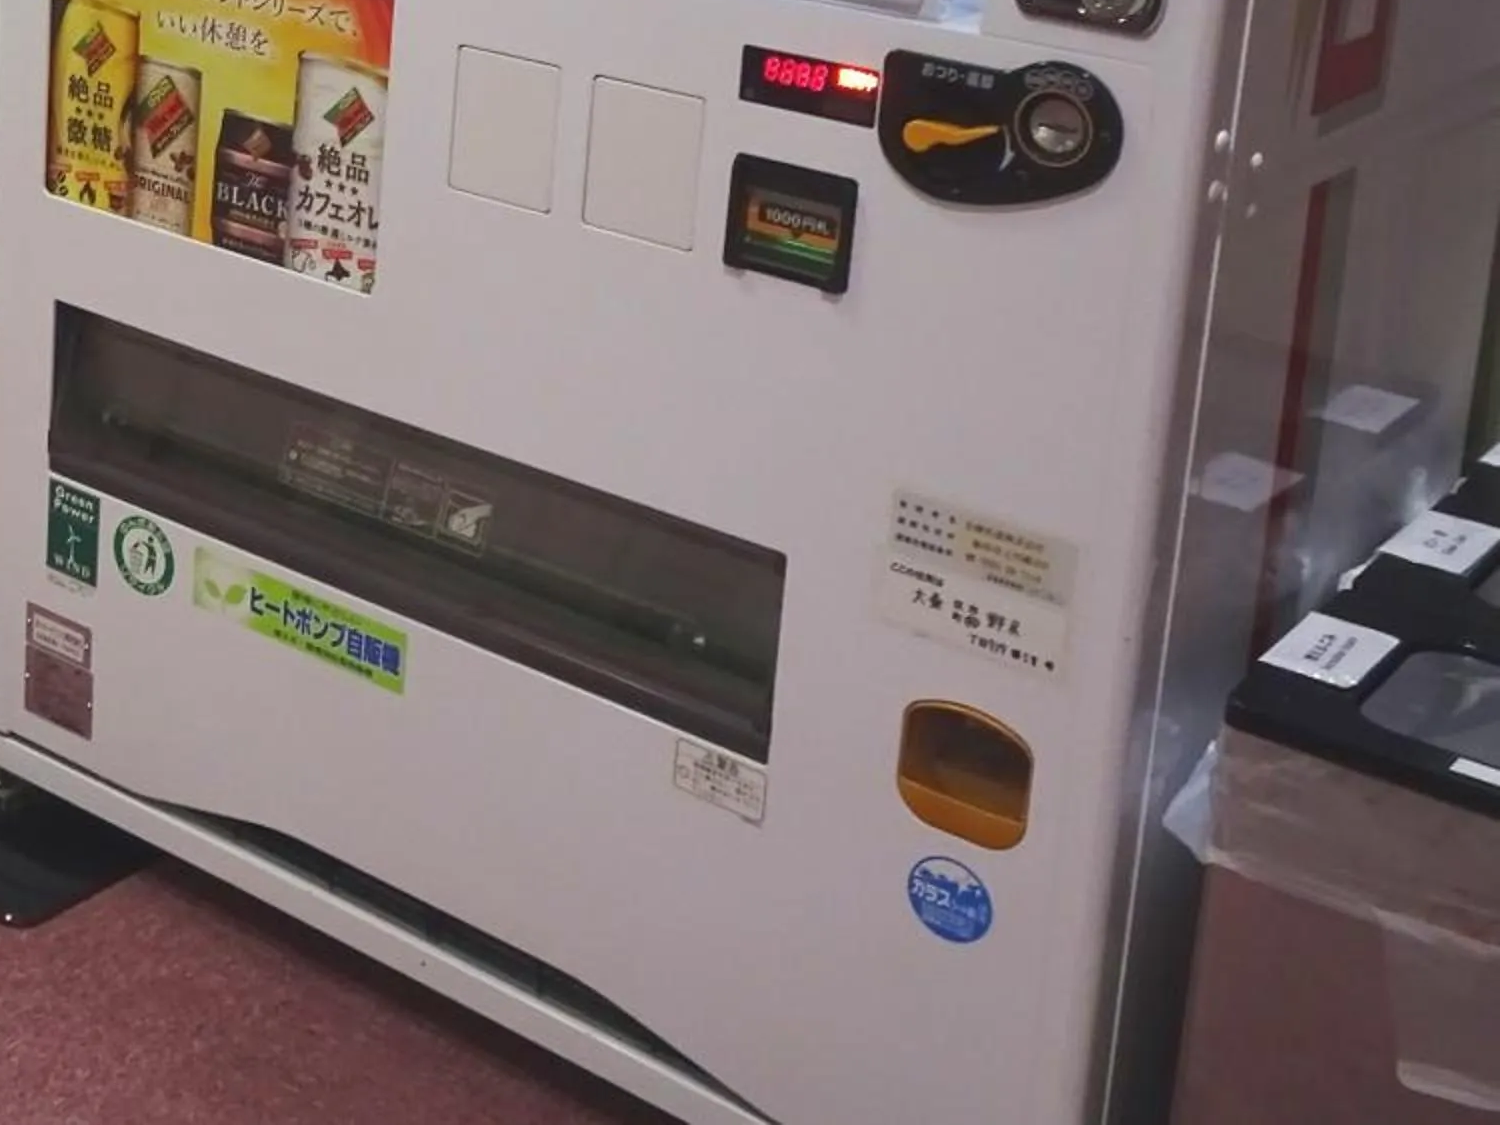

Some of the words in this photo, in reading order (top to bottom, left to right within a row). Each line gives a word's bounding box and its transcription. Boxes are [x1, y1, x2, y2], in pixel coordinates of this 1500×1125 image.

[156, 10, 271, 57] いい休憩を
[67, 73, 114, 111] 絶品
[317, 142, 370, 186] 絶品
[250, 586, 401, 676] ヒートポンプ自販機
